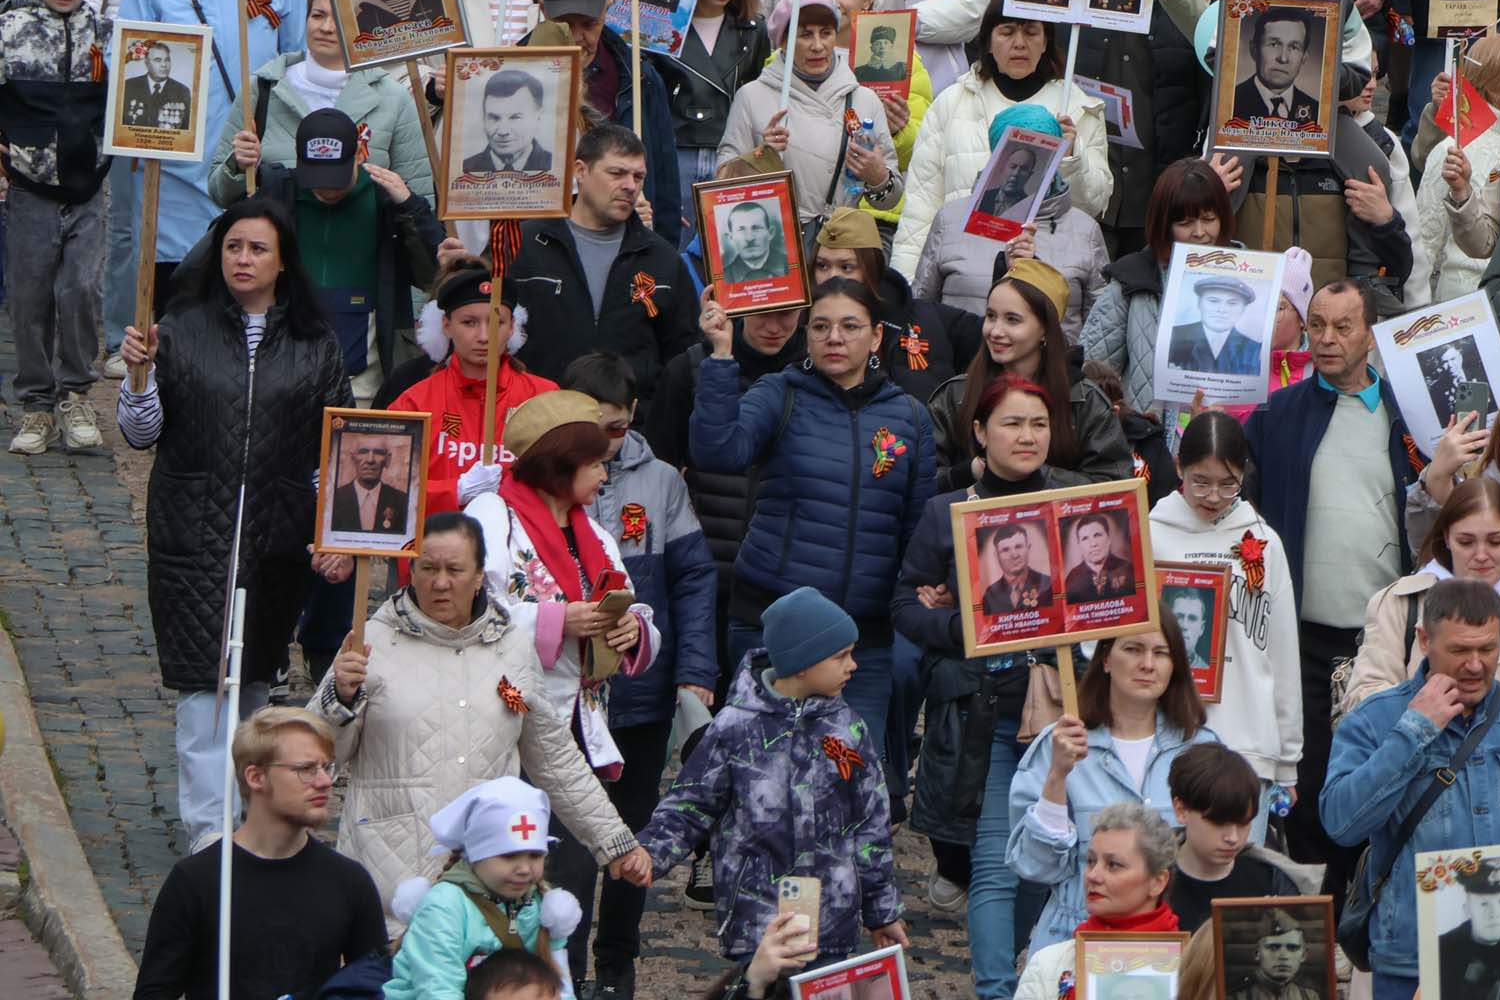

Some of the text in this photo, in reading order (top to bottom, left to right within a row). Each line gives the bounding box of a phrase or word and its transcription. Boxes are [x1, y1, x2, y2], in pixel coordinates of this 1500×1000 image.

[309, 138, 339, 147] SPARTAK
[1079, 597, 1126, 612] КИРИЛЛОВА
[998, 611, 1040, 624] КИРИЛЛОВ
[1098, 605, 1135, 619] ТИМОФЕЕВНА
[989, 618, 1049, 633] СЕРГЕЙ ИВАНОВИЧ
